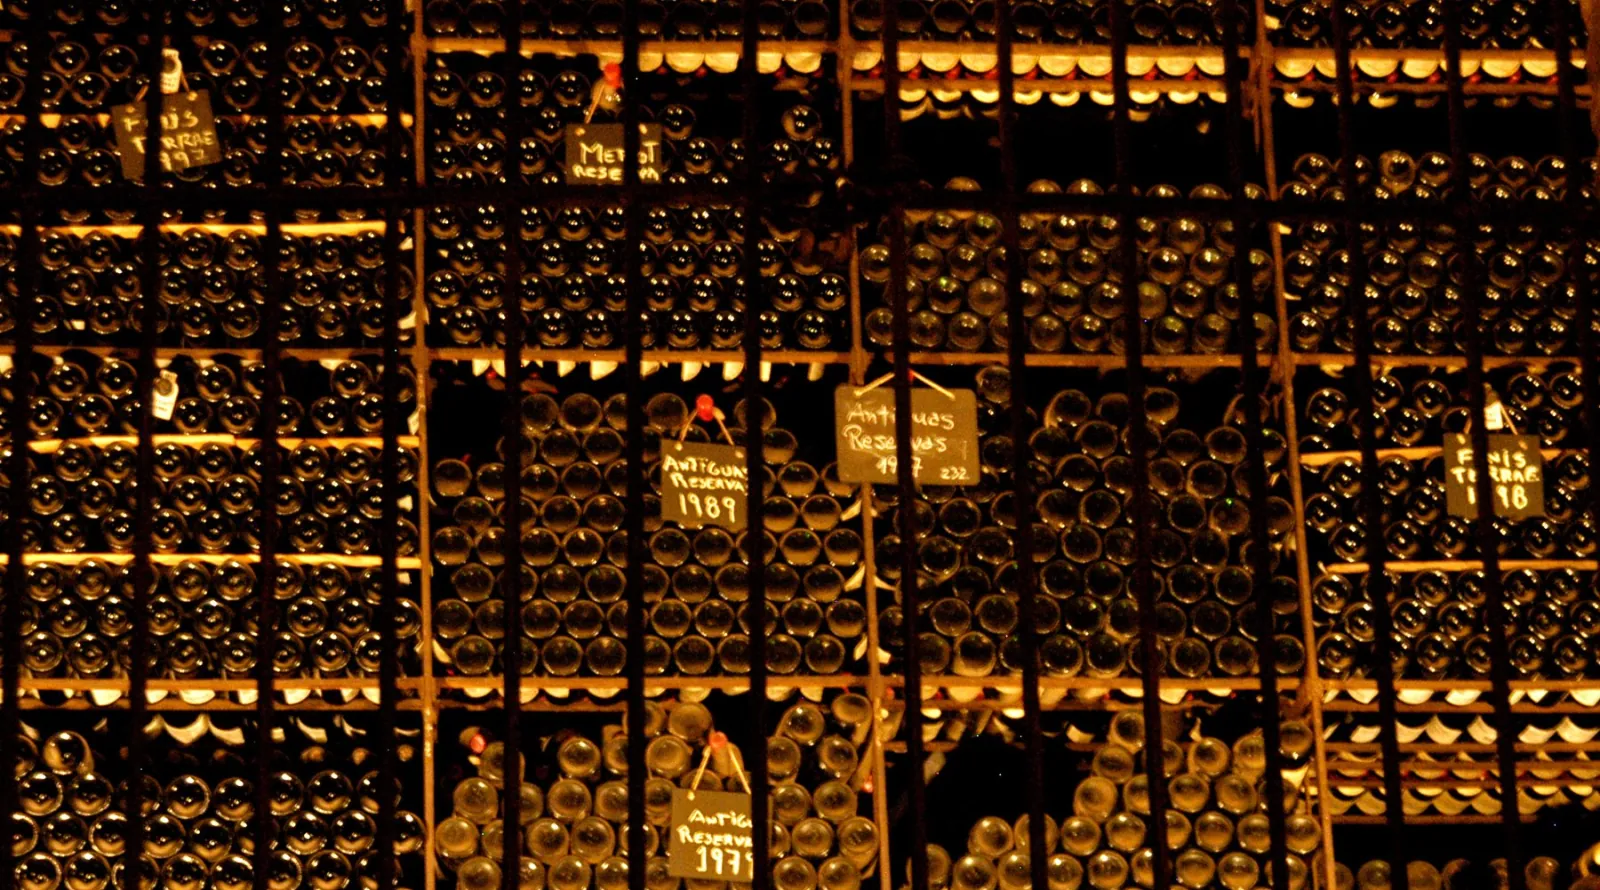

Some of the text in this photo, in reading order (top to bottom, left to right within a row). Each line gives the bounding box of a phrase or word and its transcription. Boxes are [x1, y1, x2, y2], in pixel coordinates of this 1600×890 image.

[130, 130, 215, 154] TRRAE
[847, 403, 955, 430] Antiuas
[842, 424, 947, 453] Resevas
[876, 455, 923, 478] 197
[939, 467, 970, 480] 232
[679, 492, 736, 523] 1989
[1467, 484, 1528, 510] 198
